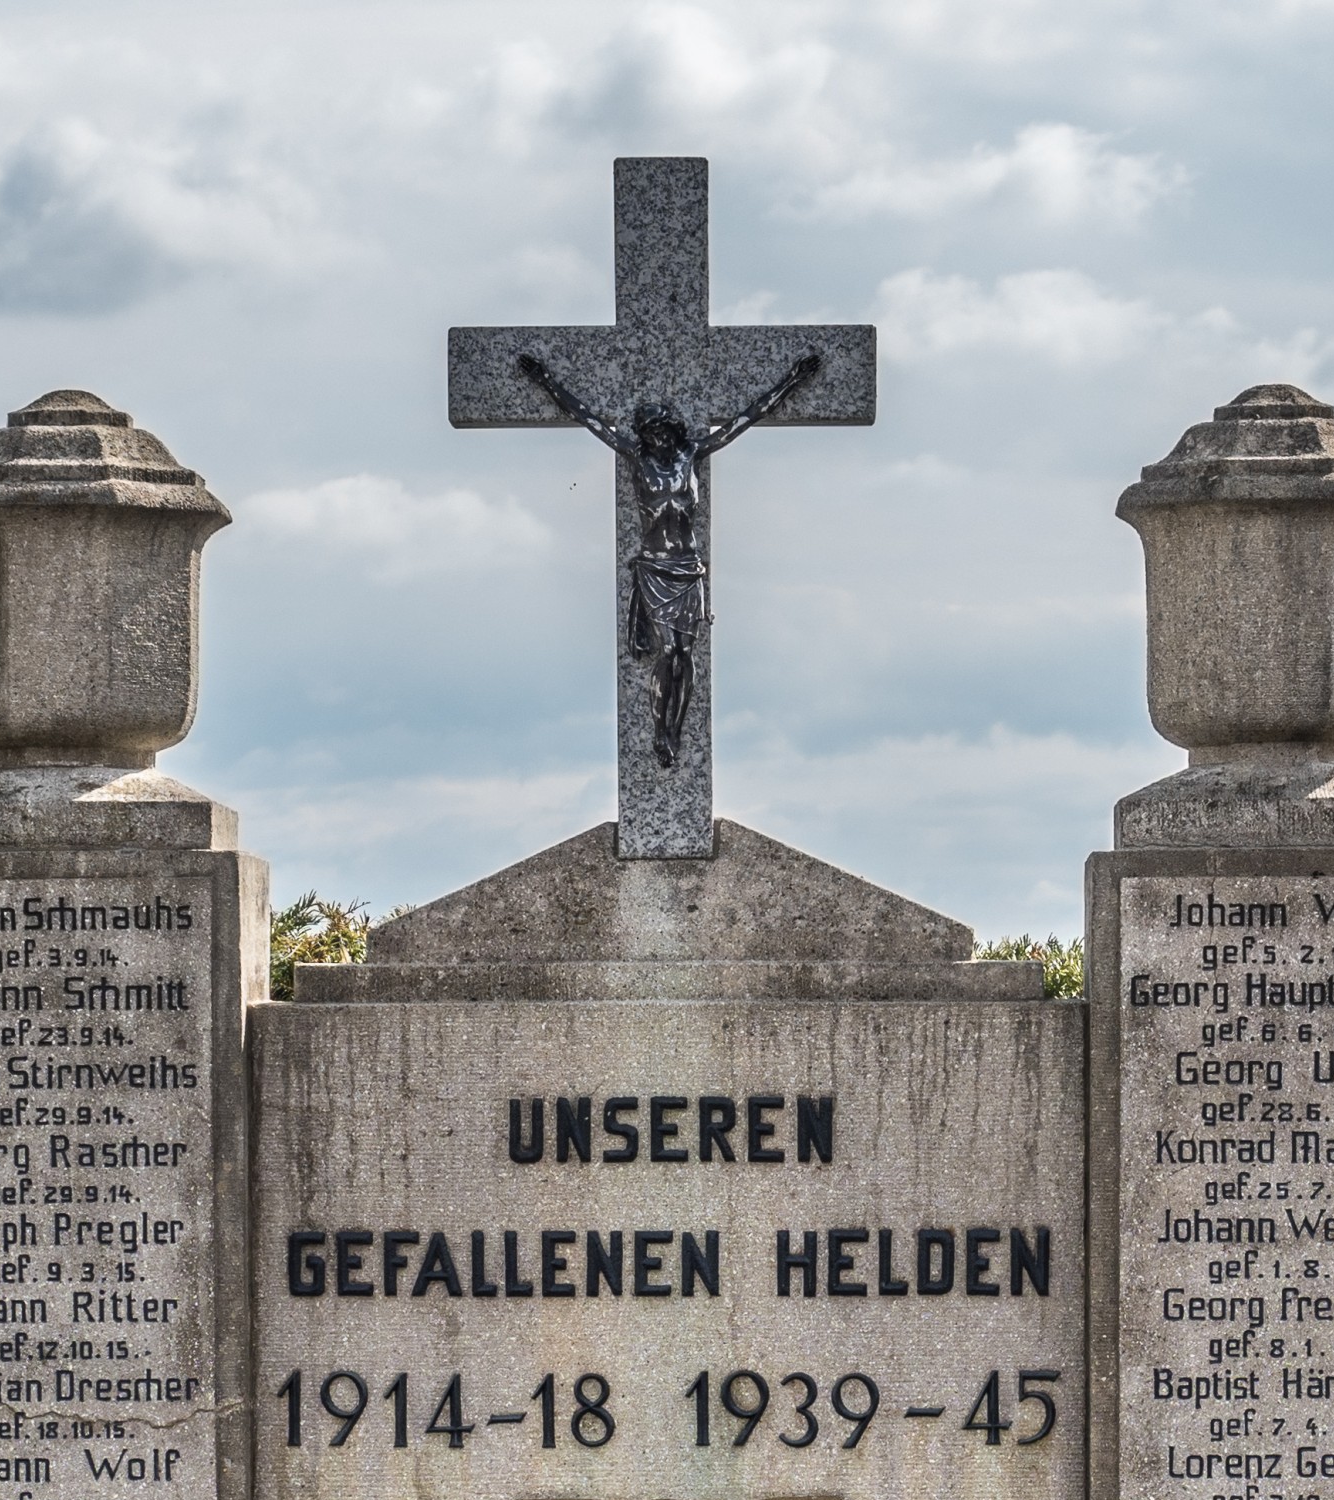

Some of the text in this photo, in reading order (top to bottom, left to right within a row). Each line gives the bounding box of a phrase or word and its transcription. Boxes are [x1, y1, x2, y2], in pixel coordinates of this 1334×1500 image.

[1170, 894, 1287, 928] Johann
[63, 976, 189, 1011] Schmitt
[1131, 974, 1228, 1013] Georg
[1176, 1052, 1282, 1091] Georg
[506, 1094, 835, 1165] UNSEREN
[1157, 1130, 1275, 1163] Konrad
[54, 1213, 183, 1253] Pregler
[1158, 1209, 1278, 1243] Johann
[287, 1226, 1051, 1298] GEFALLENEN HELDEN
[74, 1290, 177, 1322] Ritter
[1164, 1288, 1264, 1329] Georg
[56, 1369, 199, 1402] Drescher
[1154, 1369, 1259, 1409] Baptist
[277, 1370, 616, 1450] 1914-18
[85, 1449, 180, 1481] Wolf
[1169, 1447, 1281, 1479] Lorenz
